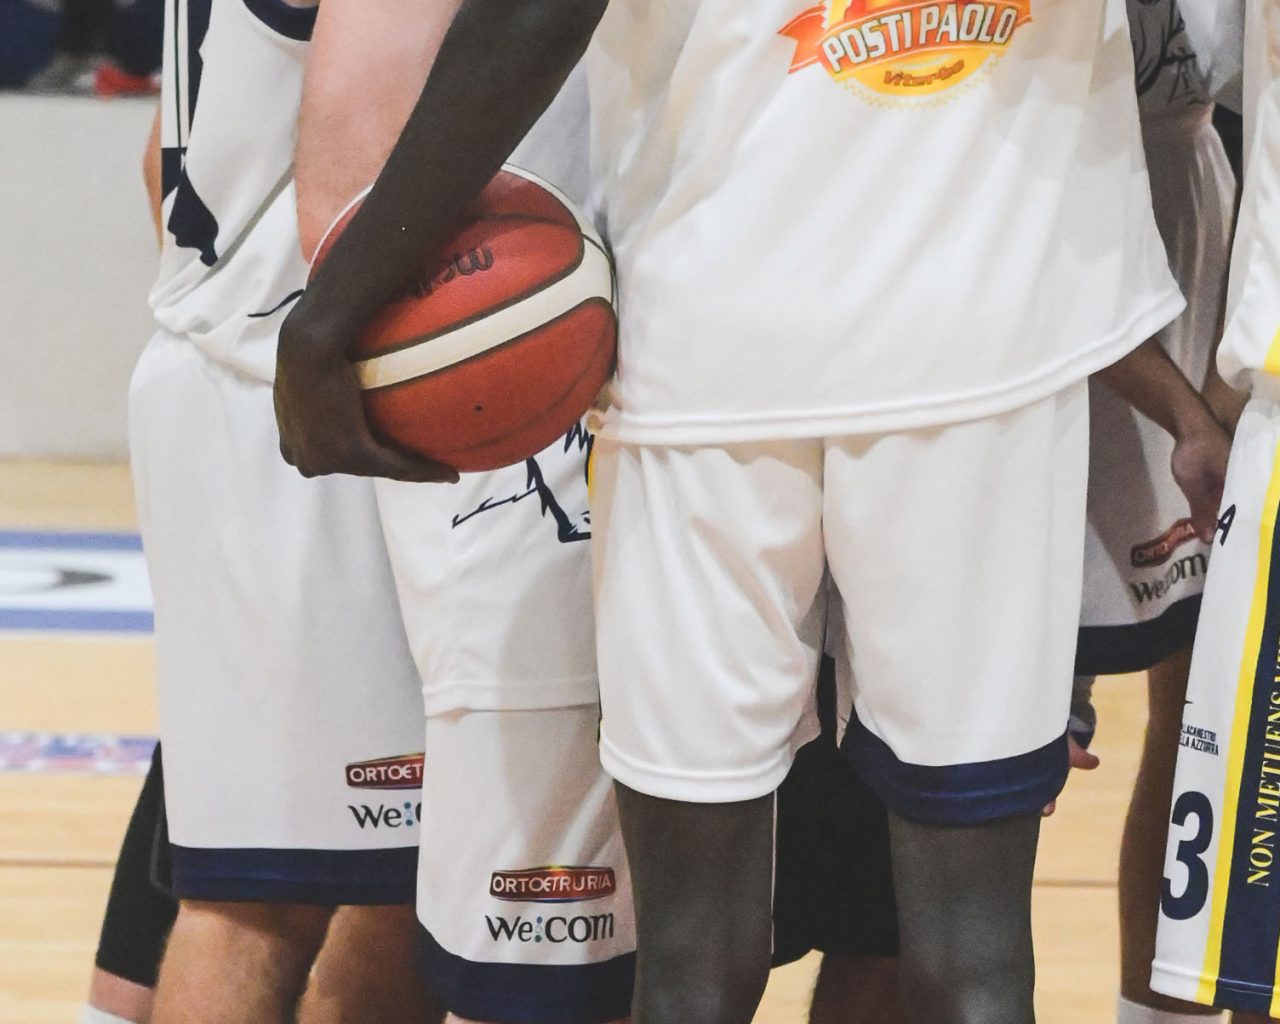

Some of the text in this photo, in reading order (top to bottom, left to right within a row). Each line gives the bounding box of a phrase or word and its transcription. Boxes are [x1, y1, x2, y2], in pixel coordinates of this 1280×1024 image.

[822, 3, 1017, 73] POSTI PAOLO
[1161, 791, 1214, 921] 3
[1247, 828, 1275, 888] NON
